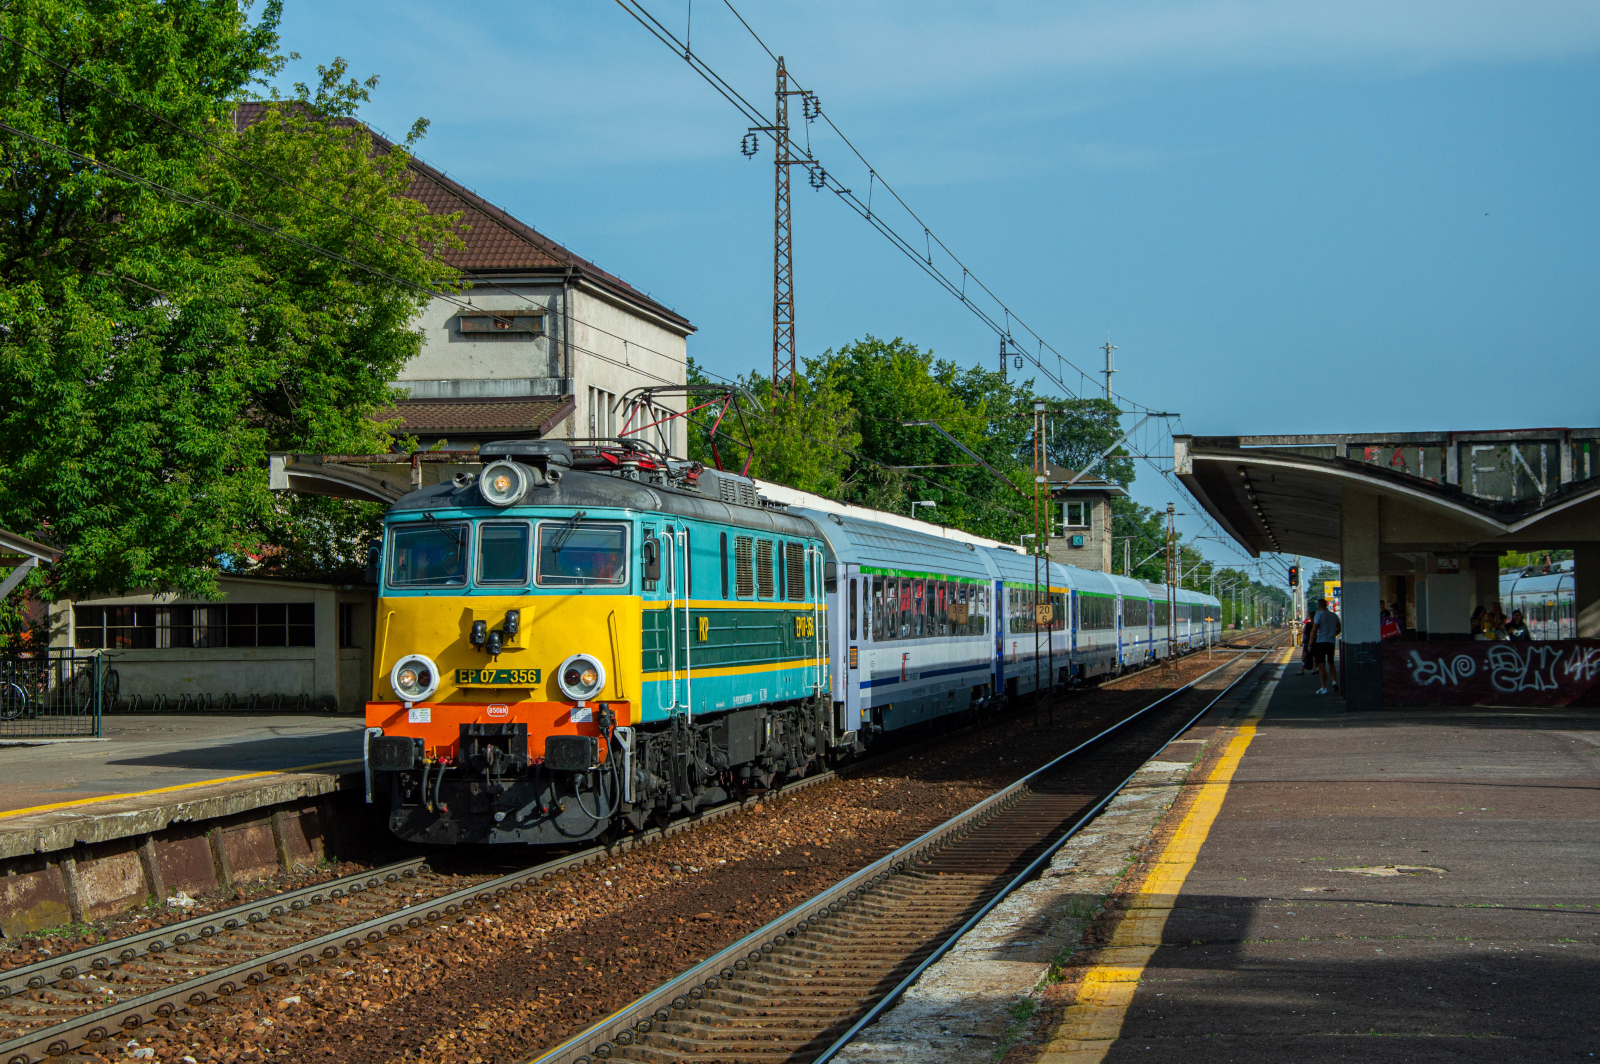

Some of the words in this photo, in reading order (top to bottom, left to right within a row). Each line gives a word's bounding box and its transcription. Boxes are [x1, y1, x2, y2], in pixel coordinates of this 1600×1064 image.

[1039, 605, 1050, 615] 20
[1042, 615, 1048, 624] 6
[459, 669, 476, 683] EP
